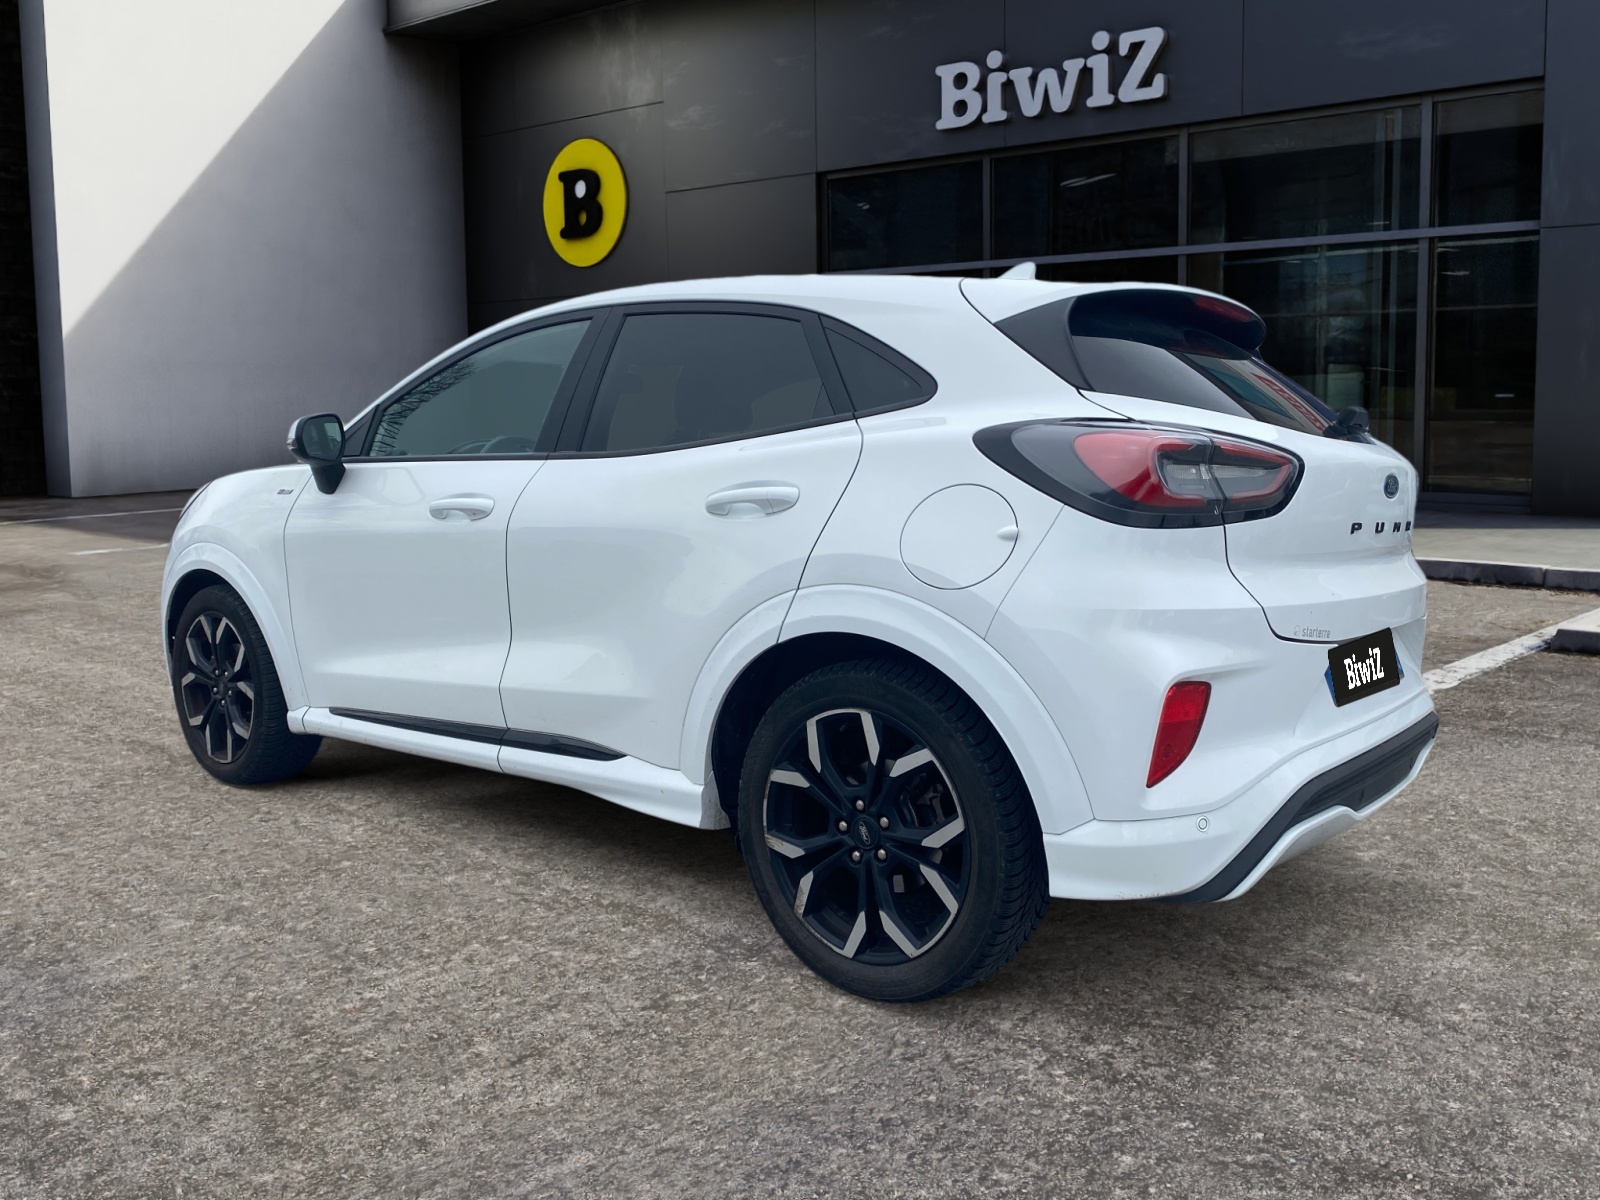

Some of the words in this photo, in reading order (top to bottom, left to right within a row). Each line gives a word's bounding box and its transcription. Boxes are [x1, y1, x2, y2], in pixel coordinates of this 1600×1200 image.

[935, 26, 1167, 130] BiwiZ
[558, 168, 603, 239] B
[1302, 626, 1331, 639] starterre
